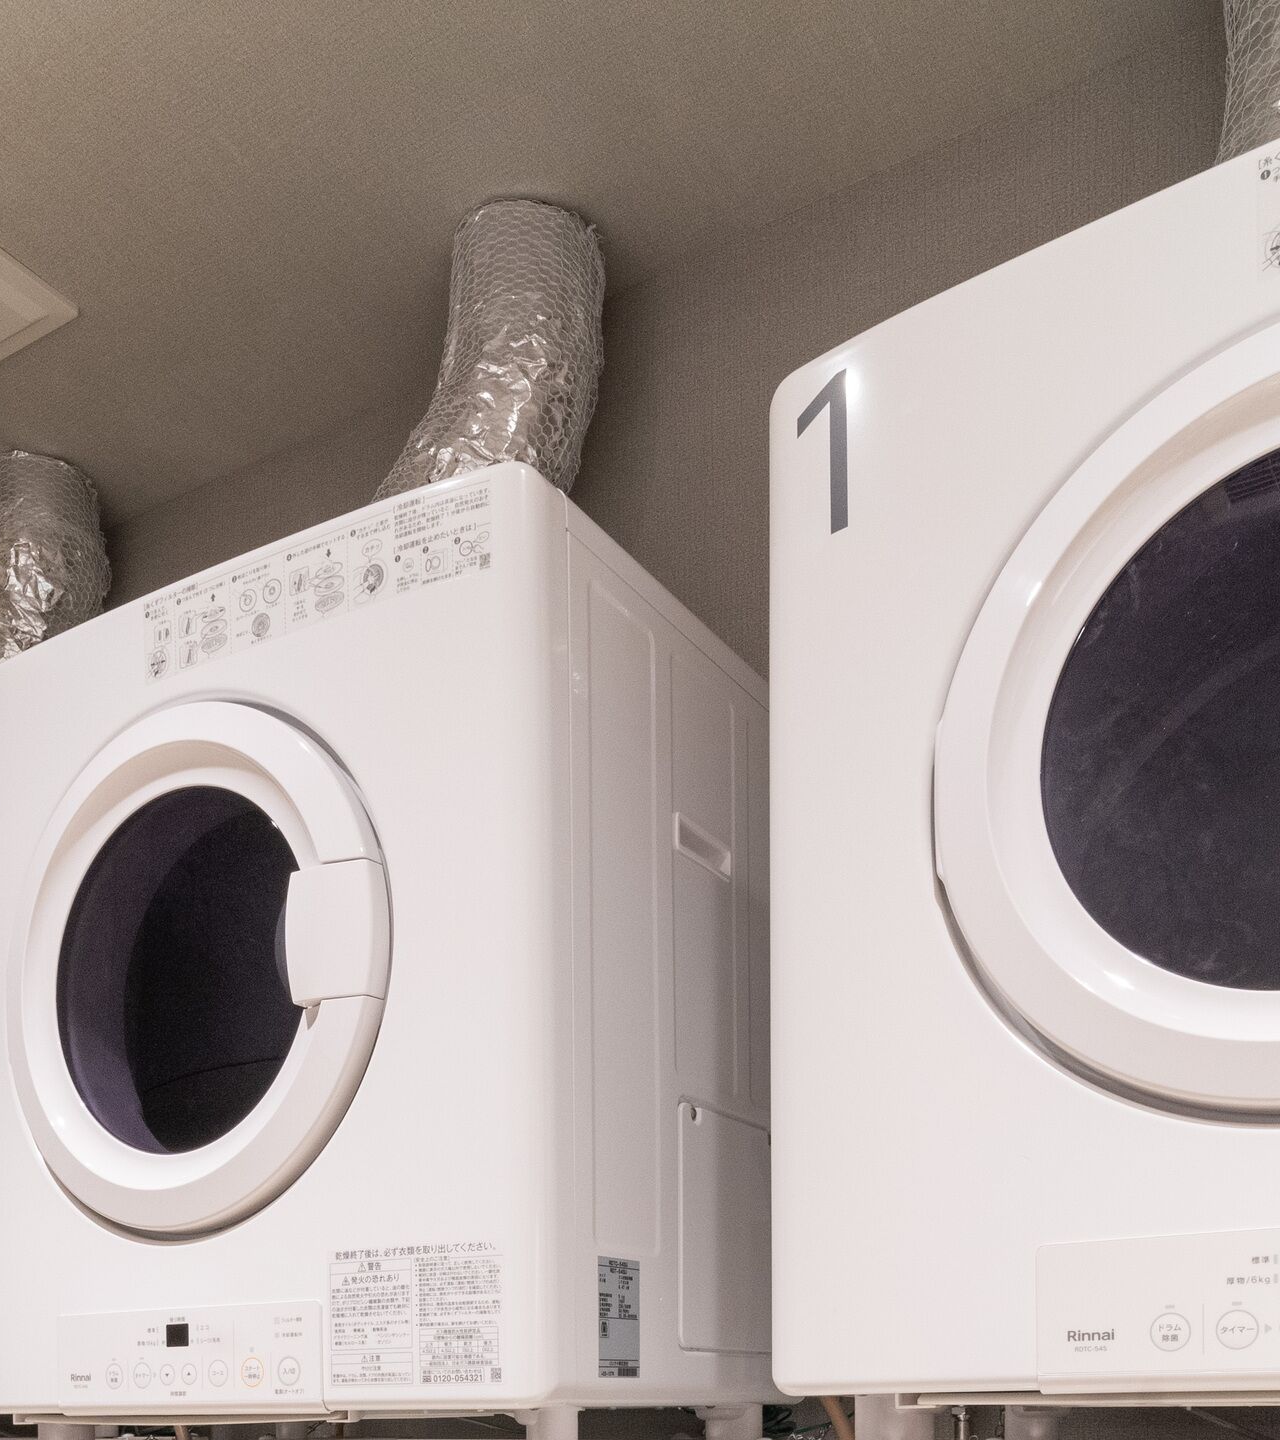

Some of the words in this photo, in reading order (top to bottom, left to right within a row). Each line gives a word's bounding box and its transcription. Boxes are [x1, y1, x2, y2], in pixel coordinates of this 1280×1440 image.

[797, 368, 848, 535] 1
[1251, 1255, 1270, 1265] 標準
[1156, 1323, 1182, 1332] ドラム
[1219, 1325, 1256, 1334] タイマー
[1067, 1328, 1115, 1342] Rinnai
[1162, 1333, 1179, 1343] 除菌
[71, 1373, 92, 1383] Rinnai
[433, 1374, 483, 1383] 0120-054321
